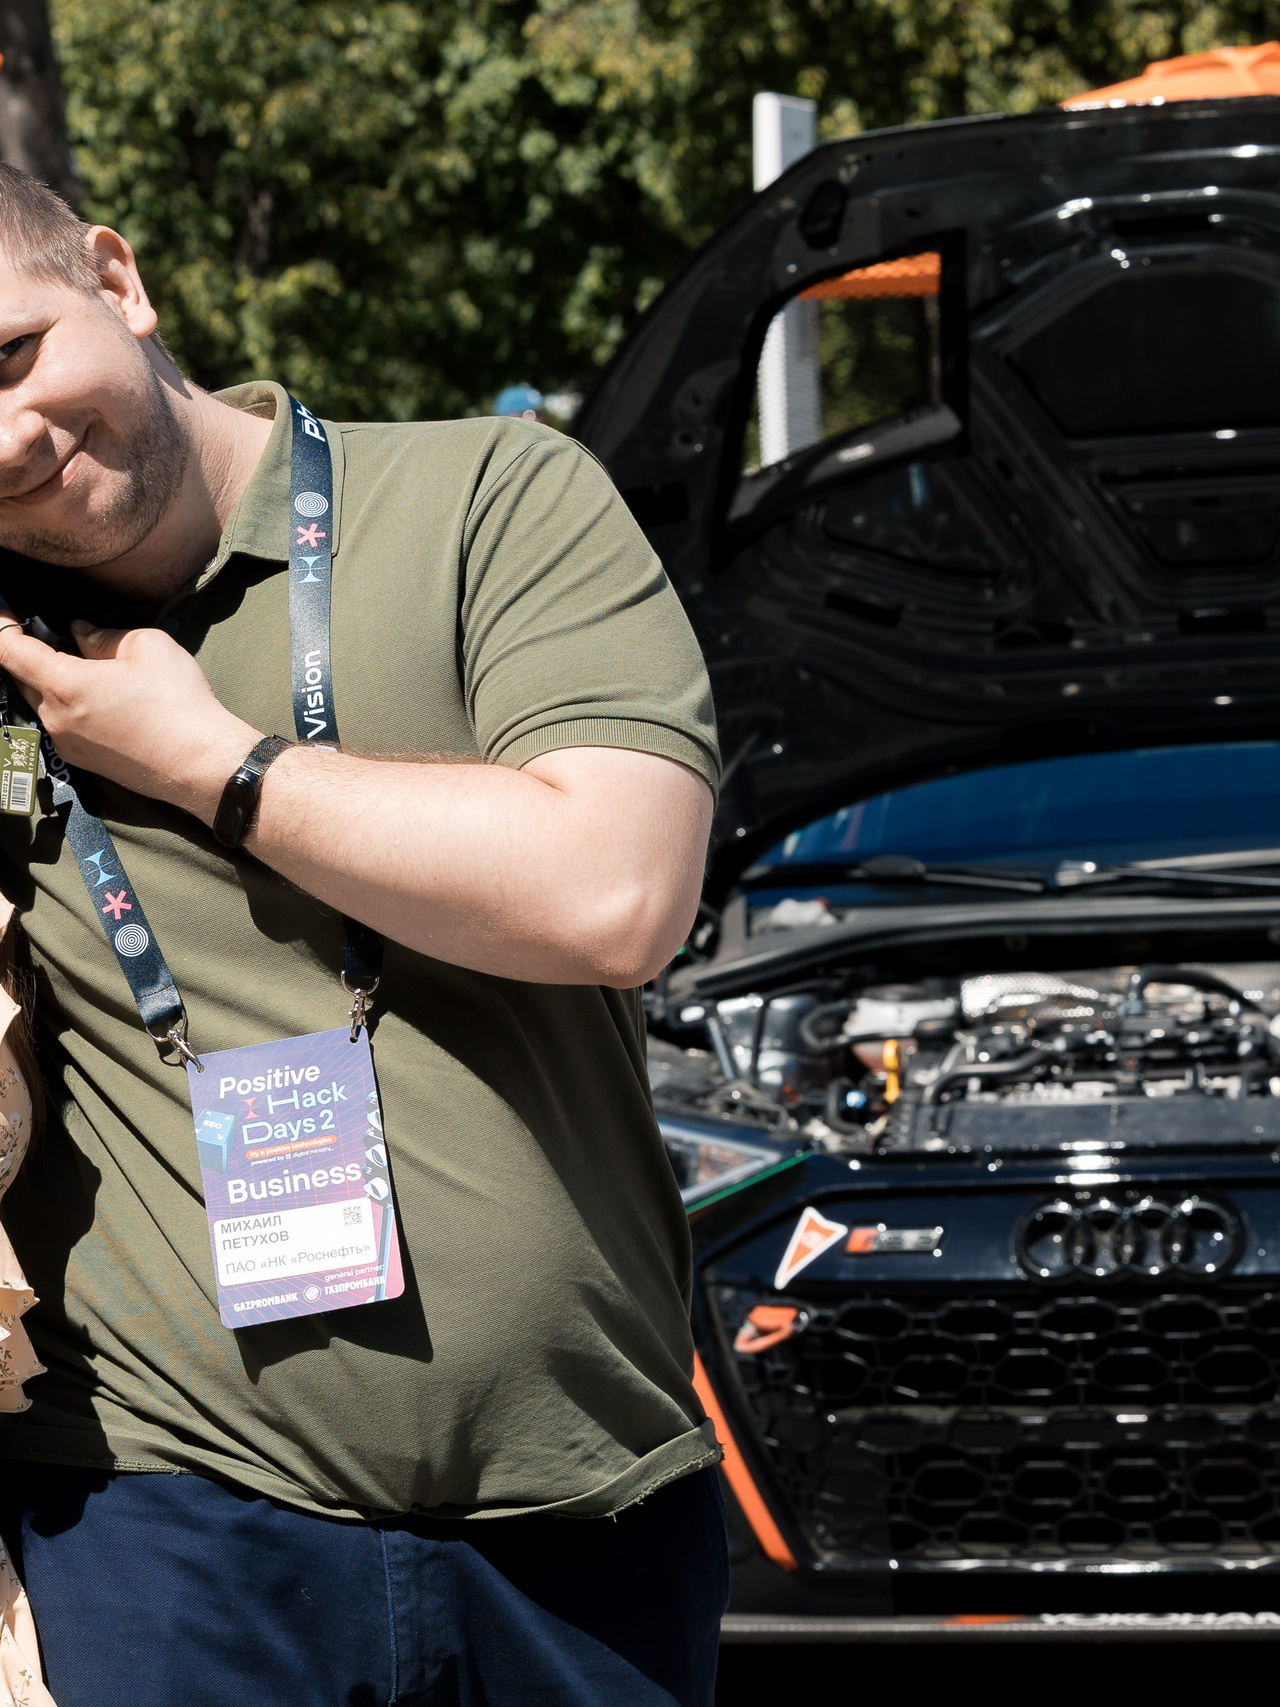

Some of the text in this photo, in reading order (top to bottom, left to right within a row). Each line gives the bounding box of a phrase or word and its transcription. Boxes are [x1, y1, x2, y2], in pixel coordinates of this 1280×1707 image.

[301, 650, 327, 739] Vision
[219, 1065, 321, 1099] Positive
[266, 1081, 348, 1115] Hack
[241, 1109, 336, 1145] Days 2
[266, 1144, 291, 1156] positive
[291, 1137, 332, 1149] technologies
[250, 1155, 276, 1167] powered
[276, 1154, 285, 1162] by
[292, 1150, 310, 1158] digital
[227, 1162, 362, 1204] Business
[220, 1215, 282, 1235] МИХАИЛ
[222, 1230, 289, 1251] ПЕТУХОВ
[225, 1244, 370, 1275] ПАО «НК «Роснефть»
[324, 1269, 354, 1283] general
[324, 1275, 386, 1296] ГАЗПРОМБАНК
[233, 1292, 298, 1313] GAZPROMBANK
